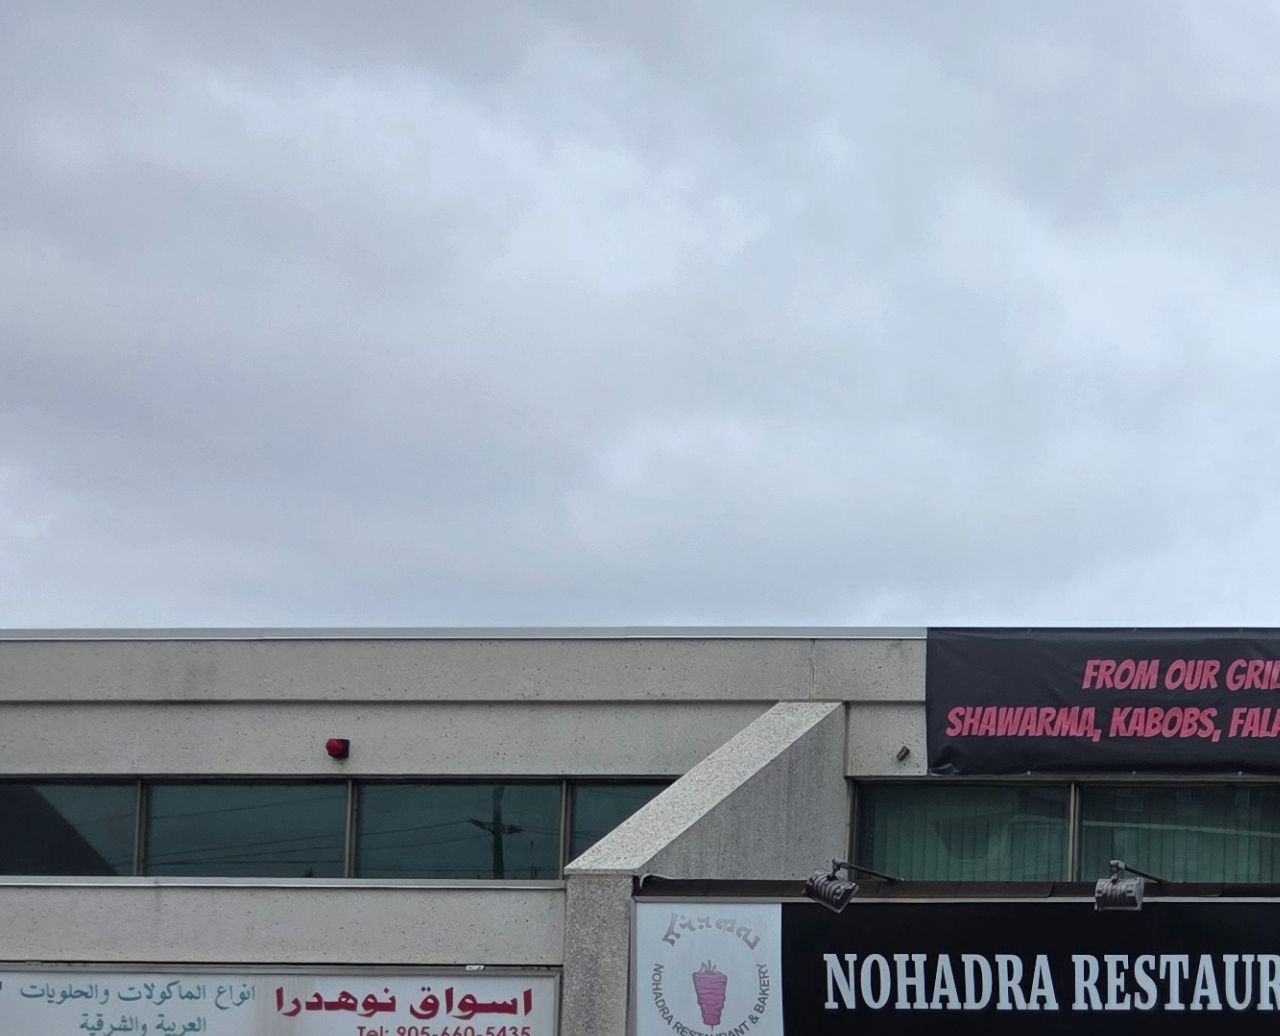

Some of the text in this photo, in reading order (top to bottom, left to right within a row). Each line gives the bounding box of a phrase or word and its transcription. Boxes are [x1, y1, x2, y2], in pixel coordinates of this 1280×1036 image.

[1082, 659, 1160, 690] FROM
[1165, 659, 1221, 691] OUR
[945, 706, 1102, 743] SHAWARMA,
[1109, 707, 1222, 743] KABOBS,
[651, 963, 675, 1026] NOHADRA
[753, 963, 770, 1014] BAKERY
[823, 954, 1060, 1013] NOHADRA
[275, 986, 533, 1021] اسواق نوهدرا
[748, 1013, 760, 1025] &
